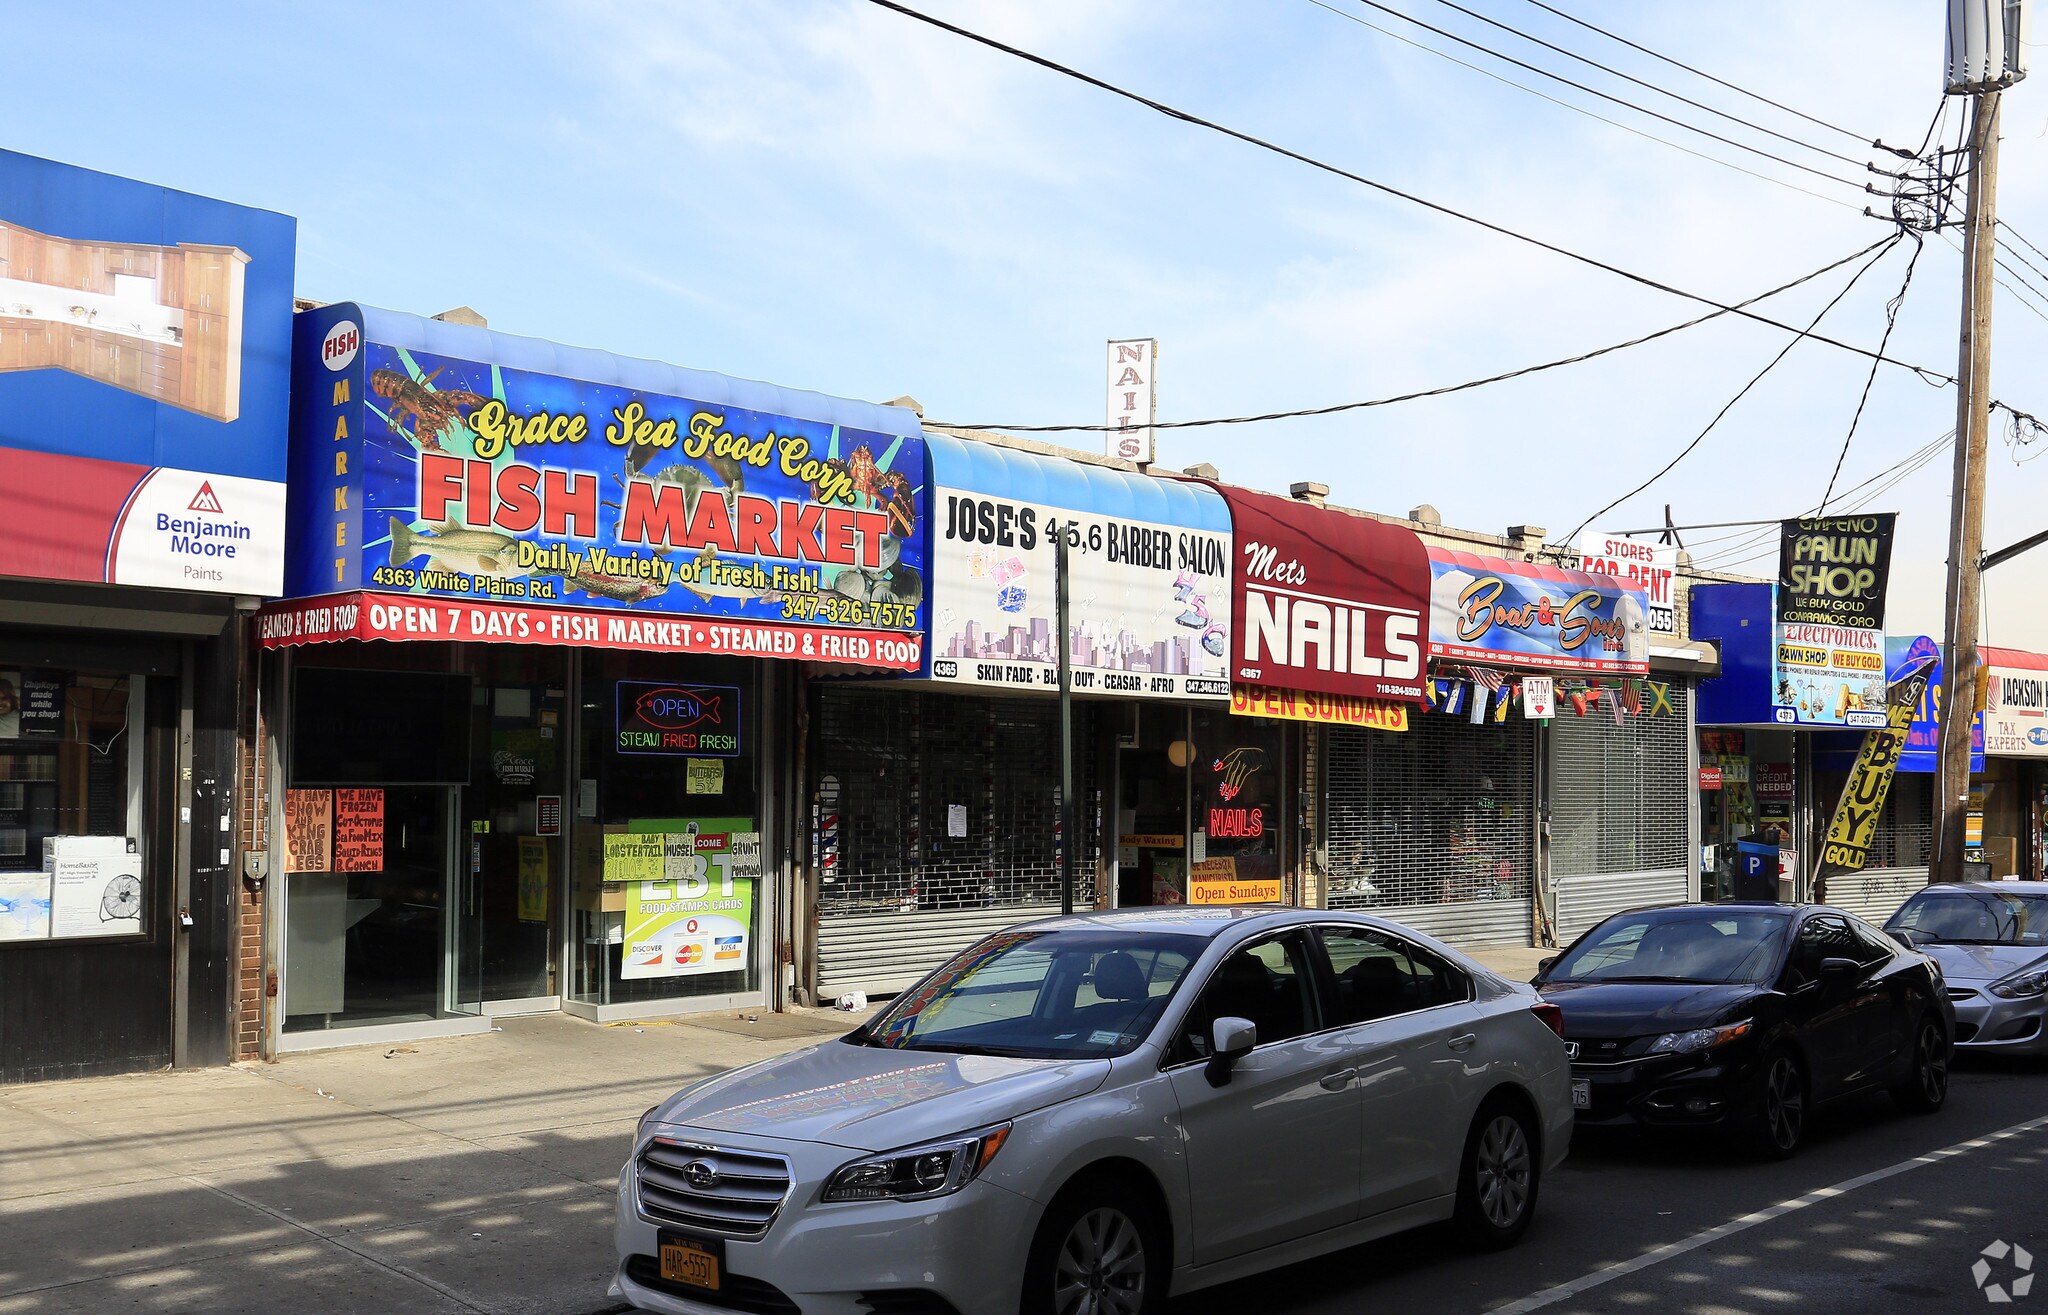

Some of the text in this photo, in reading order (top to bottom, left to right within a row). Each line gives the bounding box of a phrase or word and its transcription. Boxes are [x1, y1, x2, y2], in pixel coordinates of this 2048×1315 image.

[324, 329, 358, 361] FISH
[1115, 344, 1144, 457] NAILS
[469, 400, 855, 503] Grace Sea Food Corp.
[333, 379, 350, 582] MARKET
[421, 453, 887, 567] FISH MARKET
[156, 513, 251, 540] Benjamin
[946, 496, 1226, 578] JOSE'S BARBER SALON
[171, 536, 236, 558] Moore
[1605, 540, 1653, 562] STORES
[1794, 535, 1879, 565] PAWN
[518, 540, 819, 593] Daily Variety of Fresh Fish!
[1244, 541, 1307, 586] Mets
[184, 565, 223, 582] Paints
[1789, 565, 1875, 598] SHOP
[373, 568, 557, 598] 4363 White Plains Rd.
[1629, 564, 1672, 603] RENT
[781, 595, 916, 627] 347-326-7575
[1795, 597, 1865, 612] WE BUY GOLD
[296, 605, 358, 636] & FRIED FOOD
[1537, 596, 1555, 626] &
[1559, 590, 1626, 650] Sons
[1848, 616, 1876, 628] ORO
[369, 604, 921, 664] OPEN 7 DAYS FISH MARKET STEAMED & FRIED FOOD
[1244, 590, 1420, 680] NAILS
[1603, 638, 1624, 652] inc
[1779, 646, 1827, 664] PAWN SHOP
[1832, 652, 1882, 669] WE BUY GOLD
[935, 662, 957, 677] 4365
[1240, 667, 1261, 679] 4367
[977, 664, 1174, 693] SKIN FADE OUT CEASAR AFRO
[1527, 681, 1550, 695] ATM
[2003, 678, 2043, 707] JACKSON
[31, 700, 53, 708] while
[1232, 685, 1403, 727] OPEN SUNDAYS
[1530, 694, 1548, 704] HERE
[21, 710, 61, 719] you shop!
[652, 698, 700, 718] OPEN
[1779, 711, 1793, 720] 4373
[1885, 704, 1915, 729] WE
[1850, 715, 1884, 724] 347-202-4771
[1998, 721, 2016, 735] TAX
[619, 731, 737, 750] STEAM FRIED FRESH
[1988, 736, 2026, 751] EXPERTS
[509, 756, 534, 765] Grace
[1756, 764, 1769, 772] NO
[1756, 773, 1788, 782] CREDIT
[338, 790, 383, 801] WE HAVE
[1756, 783, 1792, 791] NEEDED
[1848, 732, 1895, 842] BUY
[286, 790, 331, 802] WE HAVE
[286, 801, 326, 817] SNOW
[340, 801, 378, 813] FROZEN
[1210, 808, 1263, 837] NAILS
[286, 824, 325, 841] KING
[641, 834, 660, 844] BABY
[1143, 836, 1176, 846] Waxing
[288, 839, 324, 855] CRAB
[665, 844, 695, 857] MUSSEL
[732, 842, 760, 855] GRUNT
[286, 854, 325, 871] LEGS
[345, 858, 378, 871] CONCH
[1750, 856, 1760, 874] P
[1825, 846, 1865, 869] GOLD
[1195, 885, 1276, 902] Open Sundays
[640, 900, 743, 914] FOOD STAMPS CARDS
[688, 921, 697, 930] &
[632, 944, 662, 953] DISCOVER
[673, 1237, 704, 1250] NEW YORK
[665, 1248, 711, 1280] HAR 5557
